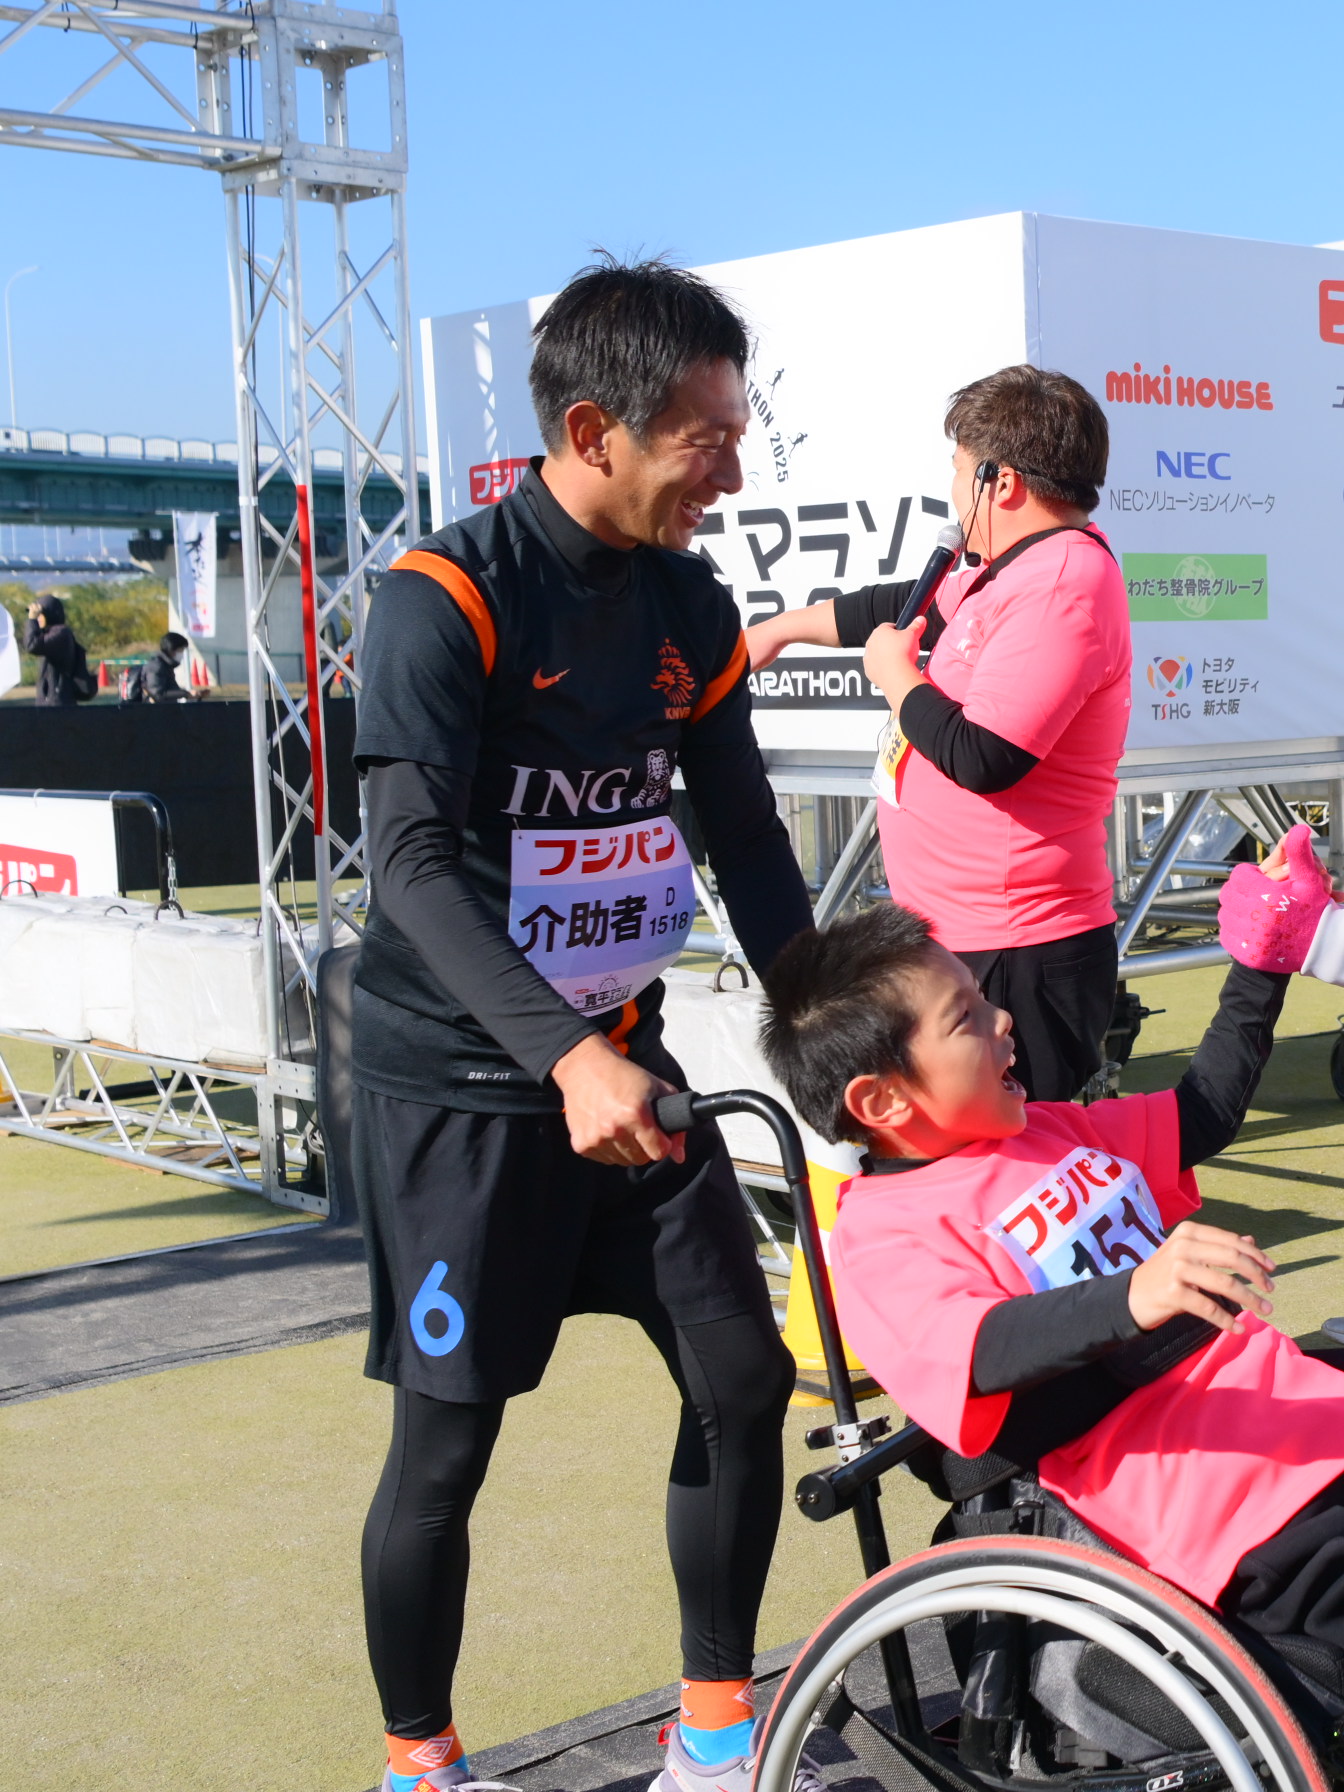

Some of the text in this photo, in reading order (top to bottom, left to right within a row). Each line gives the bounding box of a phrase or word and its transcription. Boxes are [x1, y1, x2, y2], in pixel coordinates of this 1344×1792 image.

[1176, 376, 1273, 410] HOUSE
[747, 380, 789, 483] THON 2025
[1156, 451, 1231, 480] NEC
[1110, 489, 1275, 513] NECソリューションイノベータ
[1128, 578, 1264, 597] わだち整骨院グループ
[1202, 658, 1235, 673] トヨタ
[748, 670, 862, 697] ARATHON
[1202, 679, 1260, 695] モビリティ
[1151, 704, 1191, 720] TSHG
[1203, 699, 1240, 717] 新大阪
[500, 764, 632, 817] ING
[534, 826, 676, 876] フジパン
[665, 886, 676, 907] D
[519, 895, 689, 953] 介助者 1518
[467, 1071, 511, 1081] DRI-FIT
[1003, 1151, 1123, 1257] フジパン
[1069, 1195, 1164, 1278] 151
[409, 1260, 465, 1357] 6
